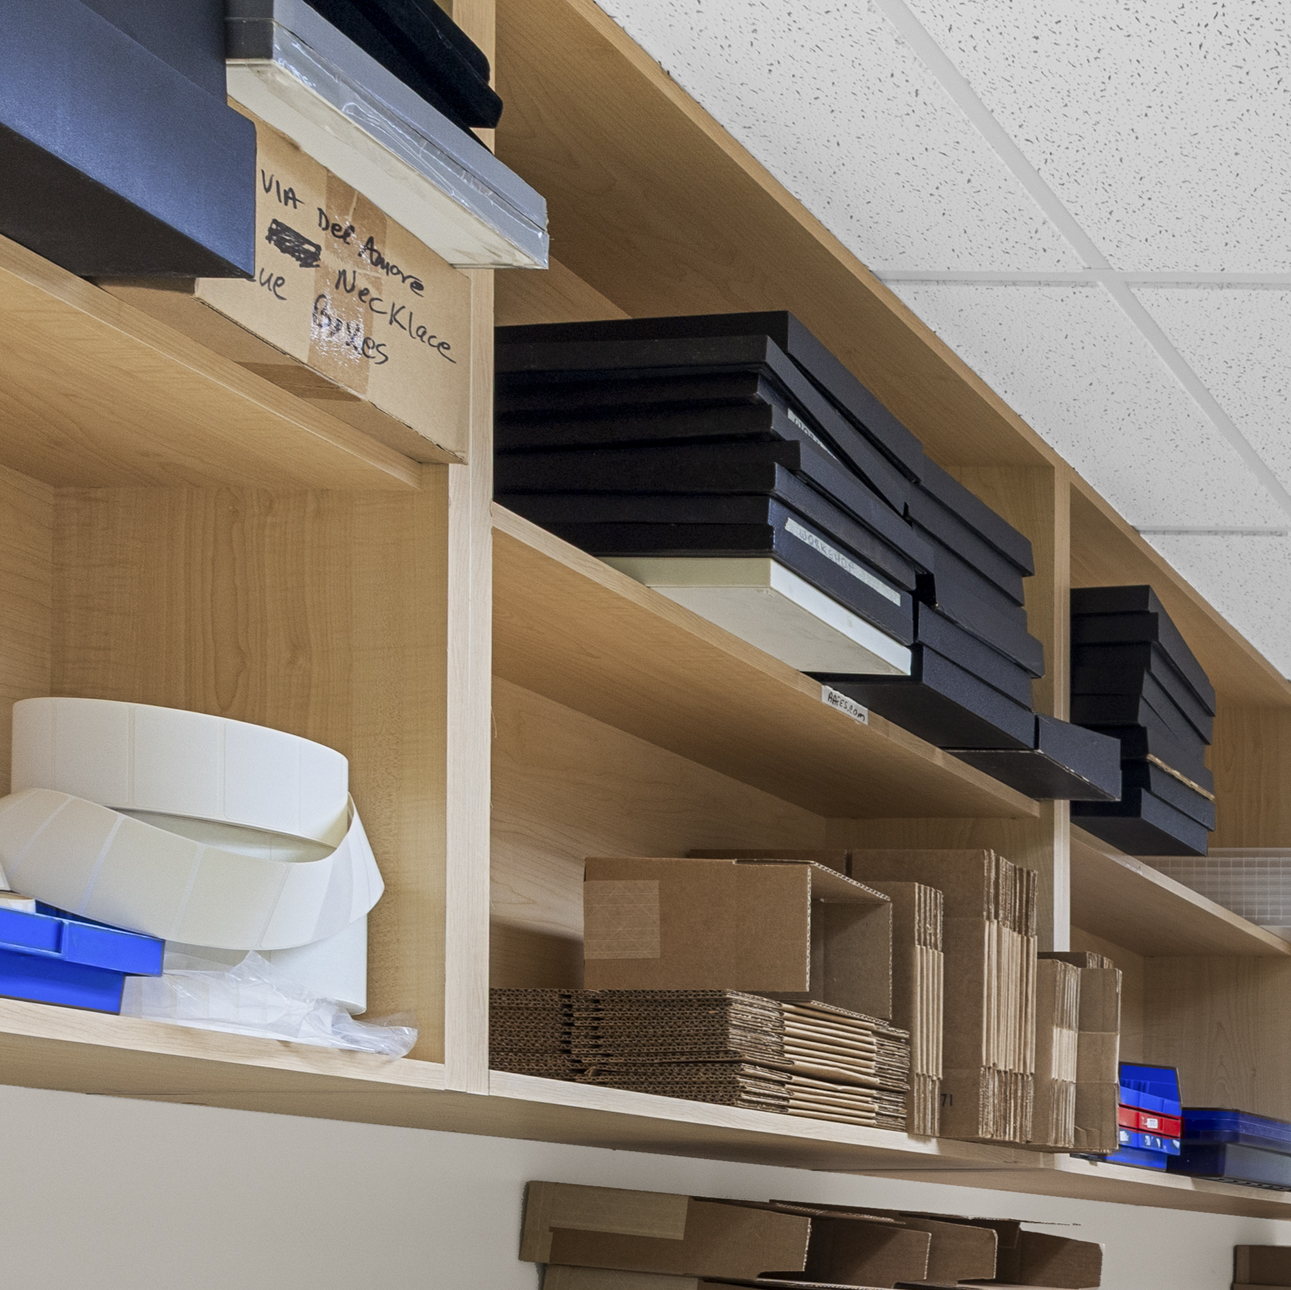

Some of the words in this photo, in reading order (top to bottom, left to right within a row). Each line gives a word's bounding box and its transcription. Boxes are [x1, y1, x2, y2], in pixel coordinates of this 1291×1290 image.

[261, 169, 304, 209] VIA
[317, 208, 355, 245] Del
[358, 236, 424, 298] Amore
[253, 268, 287, 301] ue
